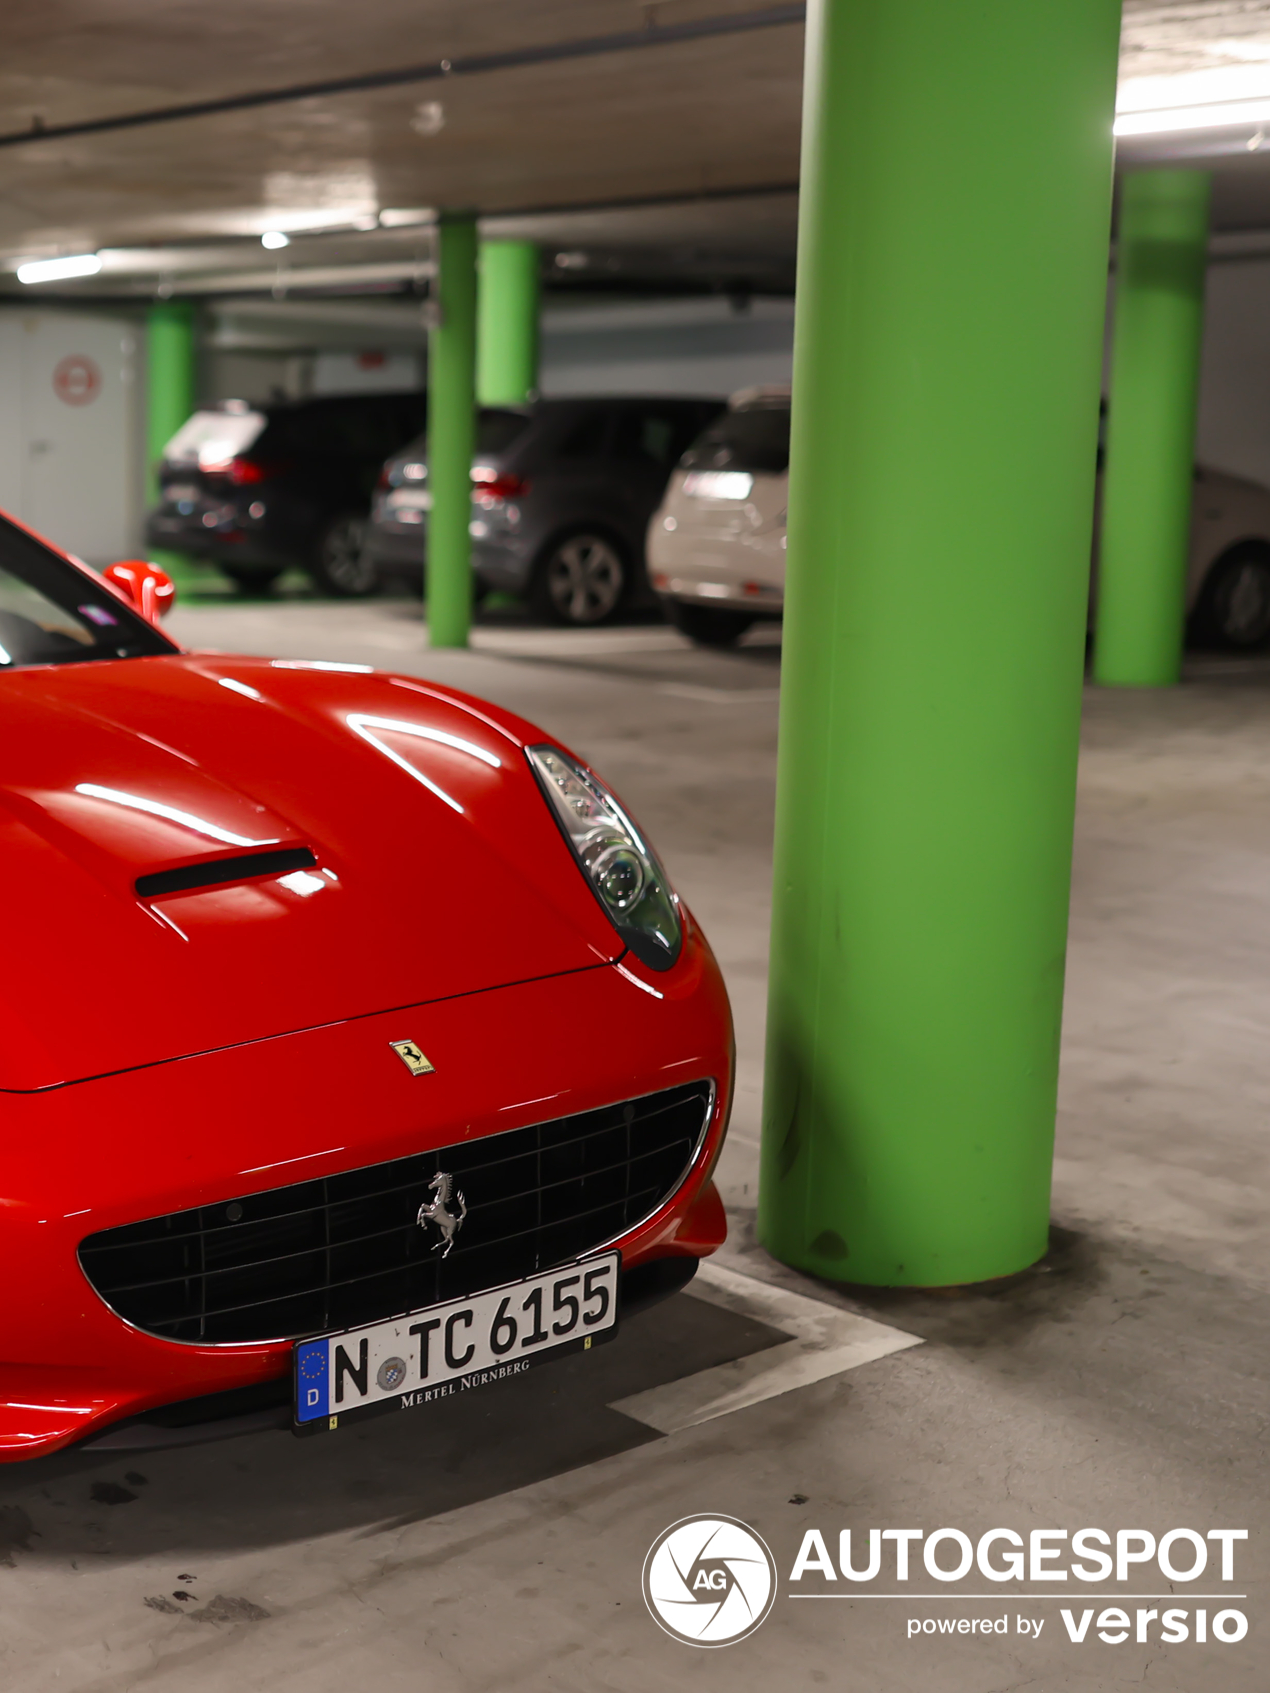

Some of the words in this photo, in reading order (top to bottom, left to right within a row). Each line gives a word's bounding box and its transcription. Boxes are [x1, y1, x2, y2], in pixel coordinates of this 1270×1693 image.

[334, 1338, 368, 1403] N
[409, 1309, 475, 1379] TC
[490, 1265, 611, 1355] 6155
[307, 1388, 320, 1406] D
[401, 1384, 455, 1409] MERTEL
[460, 1360, 530, 1391] NÜRNBERG
